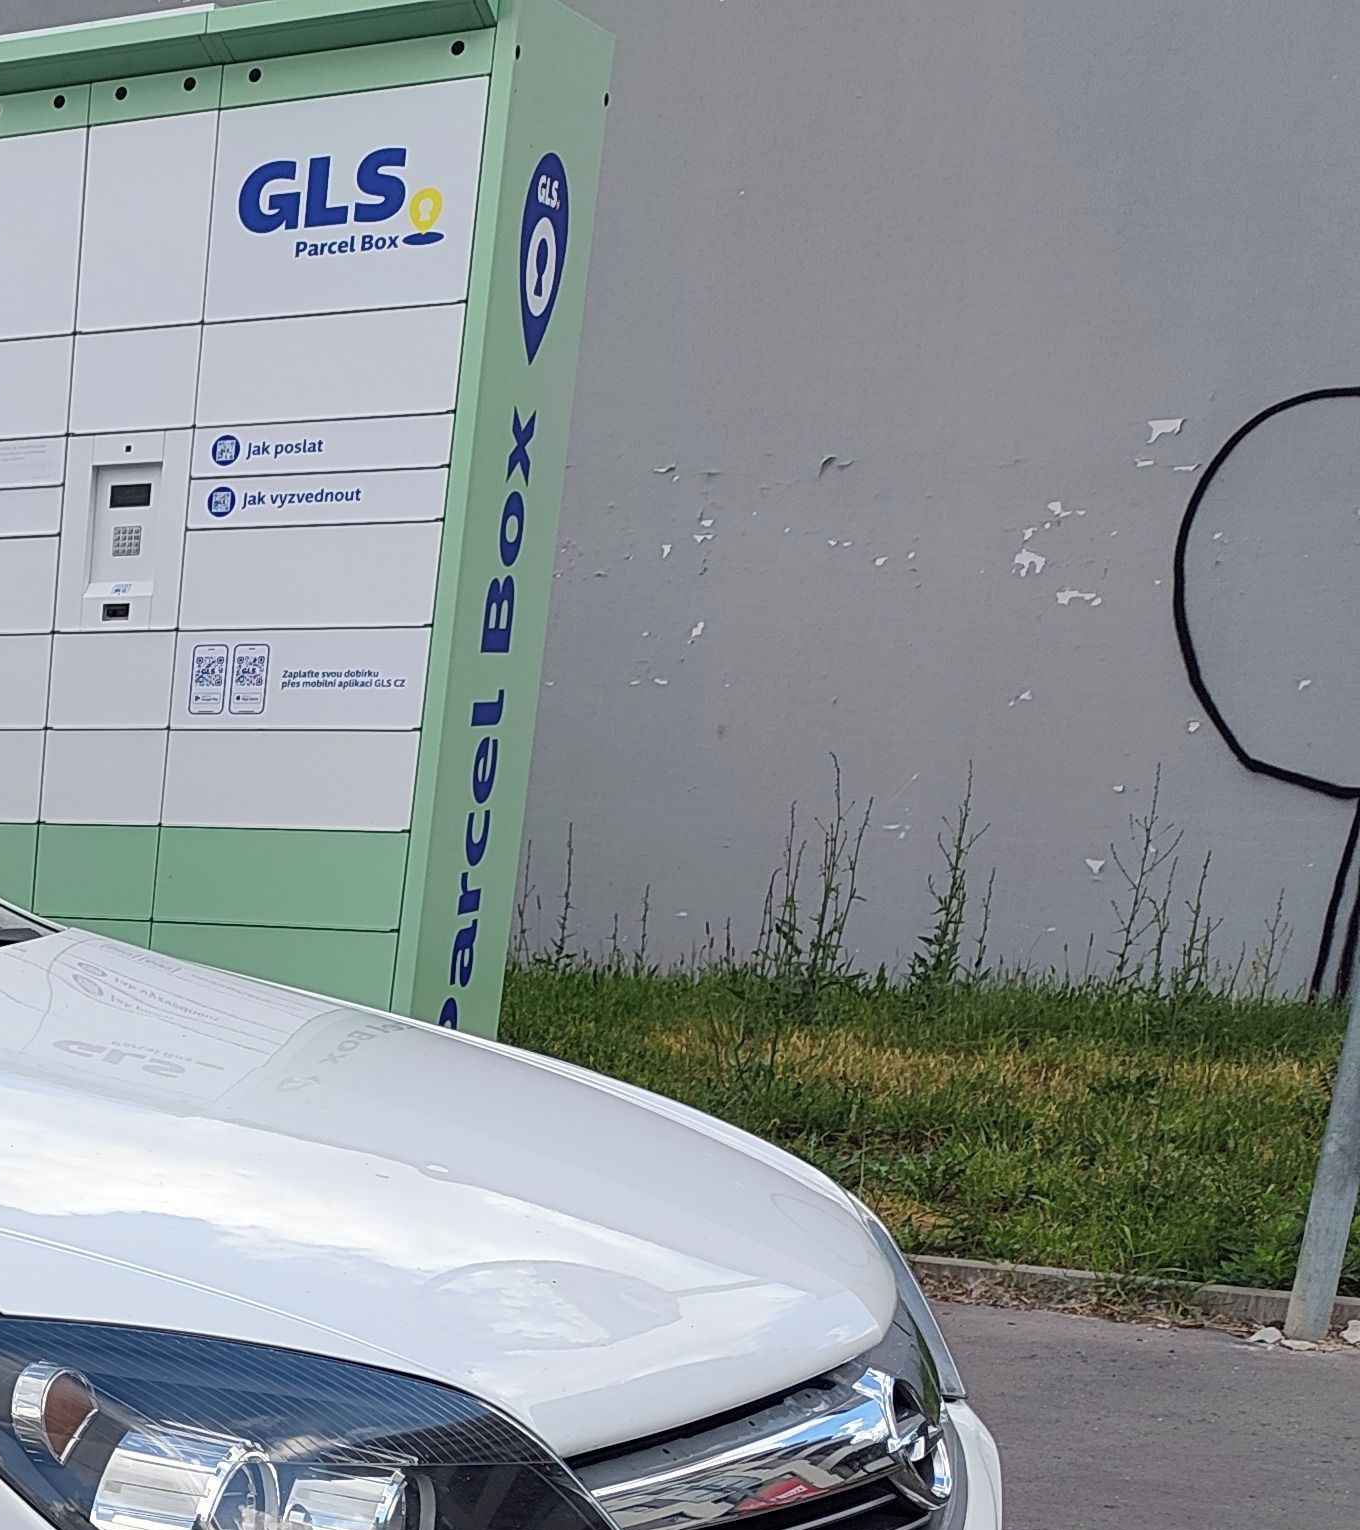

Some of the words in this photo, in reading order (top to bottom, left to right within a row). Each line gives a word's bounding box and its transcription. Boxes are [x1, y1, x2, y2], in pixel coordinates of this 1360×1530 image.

[238, 147, 407, 234] GLS
[294, 238, 356, 258] Parcel
[360, 233, 400, 252] Box
[245, 441, 271, 460] Jak
[273, 438, 324, 459] poslat
[241, 491, 266, 510] Jak
[270, 487, 362, 509] vyzvednout
[480, 405, 538, 656] Box
[281, 679, 301, 691] přes
[301, 679, 337, 689] mobilní
[338, 679, 373, 690] aplikaci
[374, 679, 392, 688] GLS
[393, 679, 406, 688] CZ
[321, 670, 343, 679] svou
[344, 669, 379, 679] dobírku
